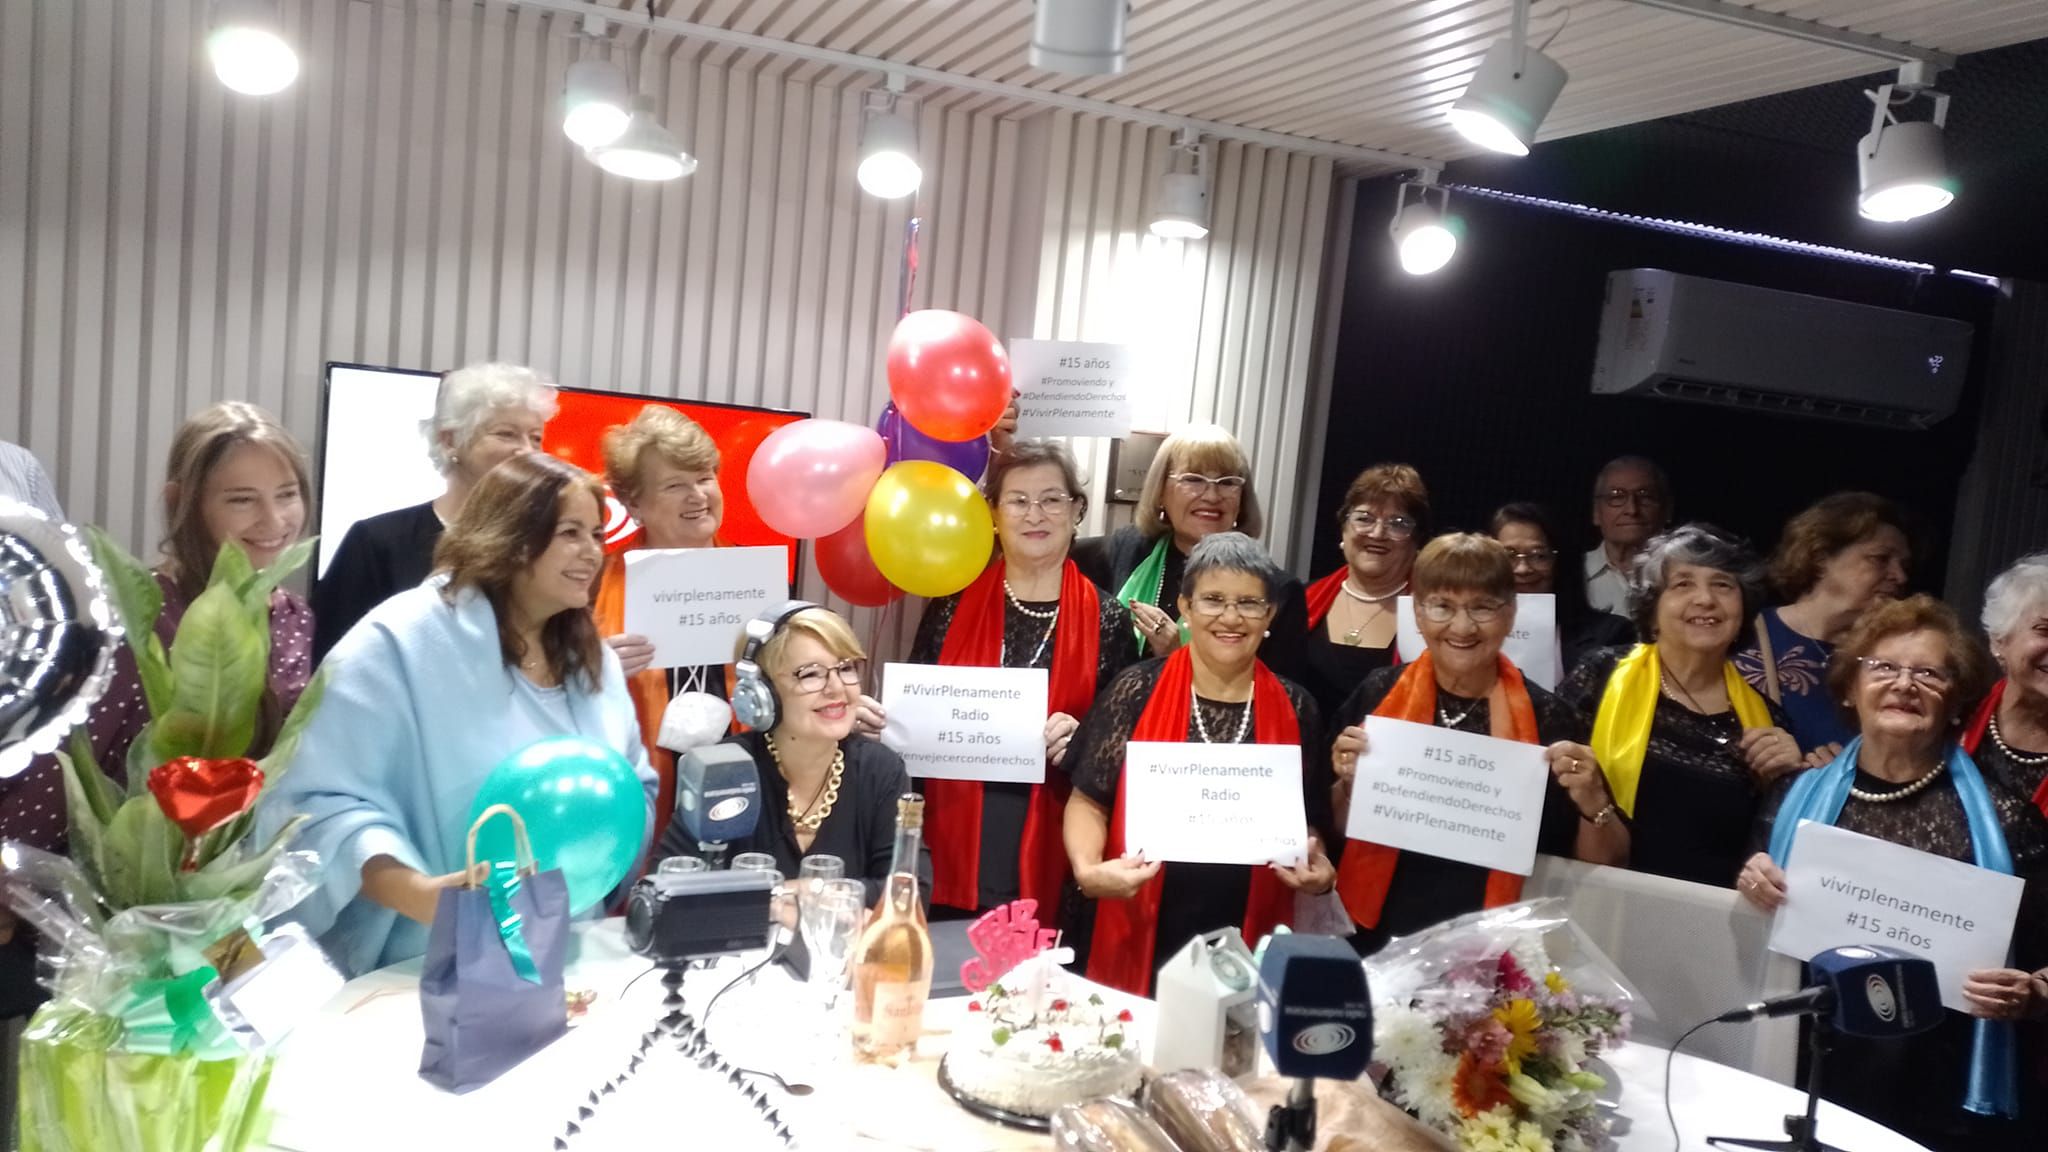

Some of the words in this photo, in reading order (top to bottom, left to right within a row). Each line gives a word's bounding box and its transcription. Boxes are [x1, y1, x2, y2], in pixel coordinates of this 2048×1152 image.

[1059, 357, 1081, 369] #15
[1084, 358, 1111, 369] años
[1041, 377, 1107, 387] #Promoviendo
[1109, 380, 1115, 389] y
[1022, 408, 1116, 418] #VivirPlenamente
[652, 588, 766, 605] vivirplenamente
[679, 613, 705, 626] #15
[709, 612, 742, 625] años
[903, 683, 1021, 700] #VivirPlenamente
[951, 708, 990, 721] Radio
[938, 731, 963, 743] #15
[968, 731, 1001, 745] años
[1424, 746, 1453, 763] #15
[1458, 753, 1496, 772] años
[1150, 763, 1273, 777] #VivirPlenamente
[1398, 767, 1491, 795] #Promoviendo
[1494, 788, 1502, 798] y
[1201, 788, 1241, 801] Radio
[1372, 781, 1523, 821] #DefendiendoDerechos
[1373, 804, 1507, 842] #VivirPlenamente
[1820, 876, 1975, 932] vivirplenamente
[1846, 911, 1881, 933] #15
[1886, 926, 1932, 950] años
